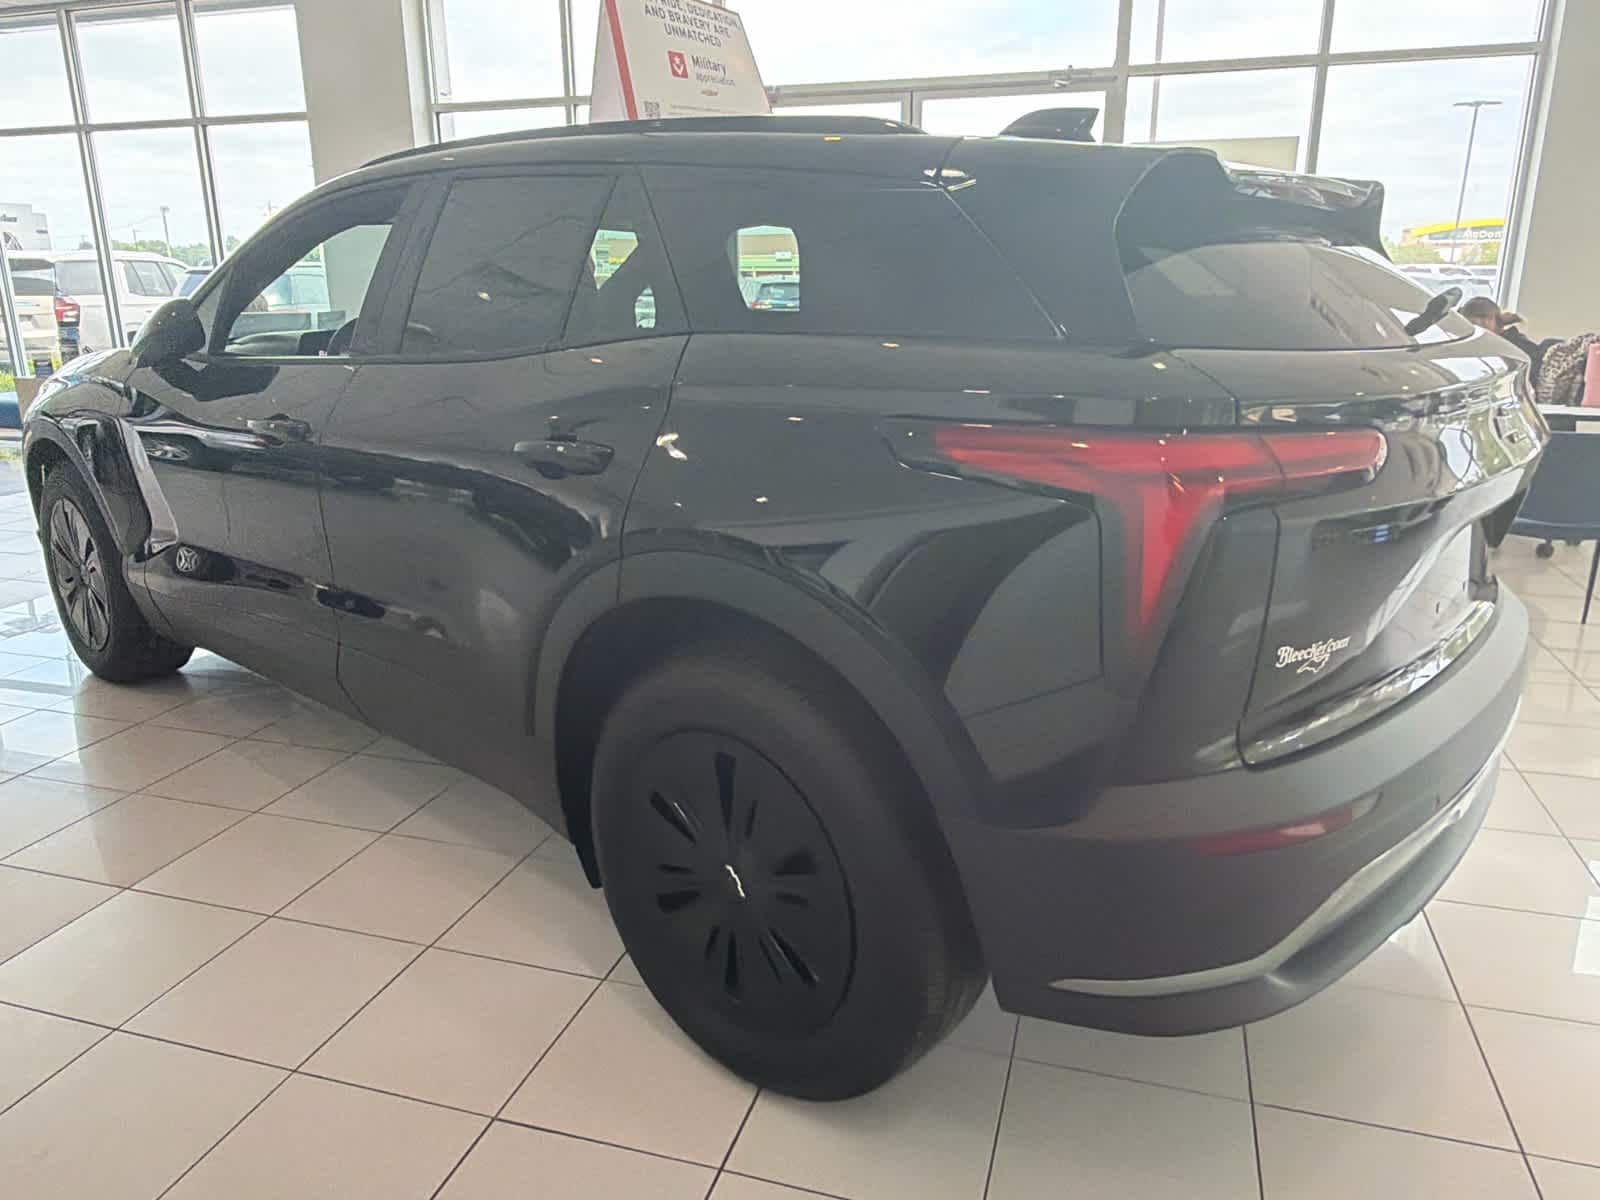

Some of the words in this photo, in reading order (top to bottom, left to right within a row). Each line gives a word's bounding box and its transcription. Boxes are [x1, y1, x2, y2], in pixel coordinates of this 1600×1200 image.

[644, 4, 666, 20] AND
[667, 10, 711, 32] BRAVERY
[713, 23, 732, 39] ARE
[664, 22, 722, 48] UNMATCHED
[691, 55, 727, 77] Military
